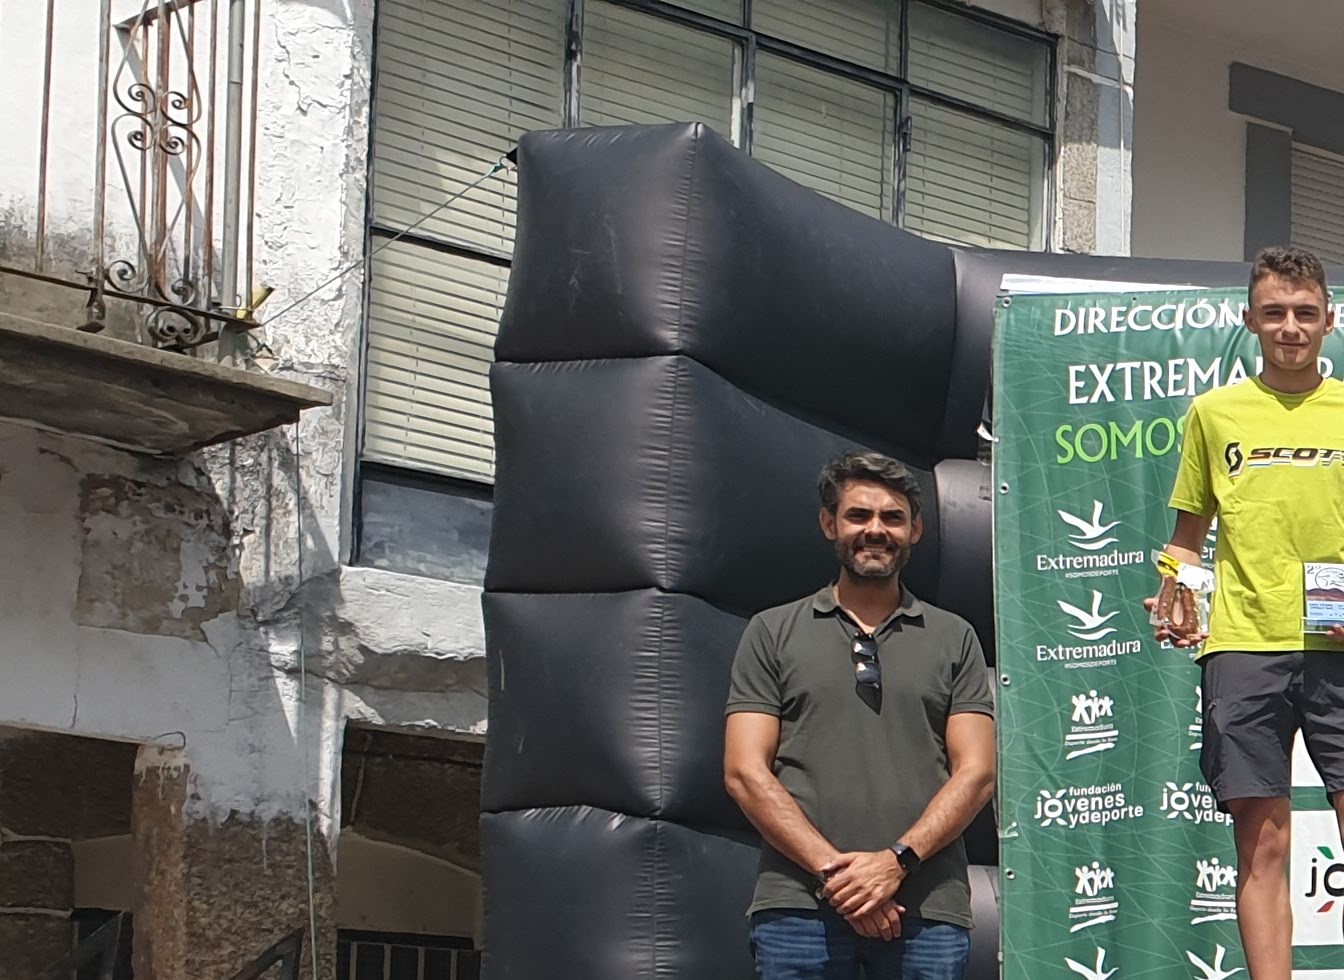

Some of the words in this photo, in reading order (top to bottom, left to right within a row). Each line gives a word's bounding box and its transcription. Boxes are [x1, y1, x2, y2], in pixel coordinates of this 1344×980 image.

[1055, 417, 1185, 465] SOMO
[1037, 549, 1144, 571] Extremadura
[1036, 639, 1141, 662] Extremadura
[1069, 783, 1122, 798] fundación
[1069, 804, 1144, 829] ydeporte
